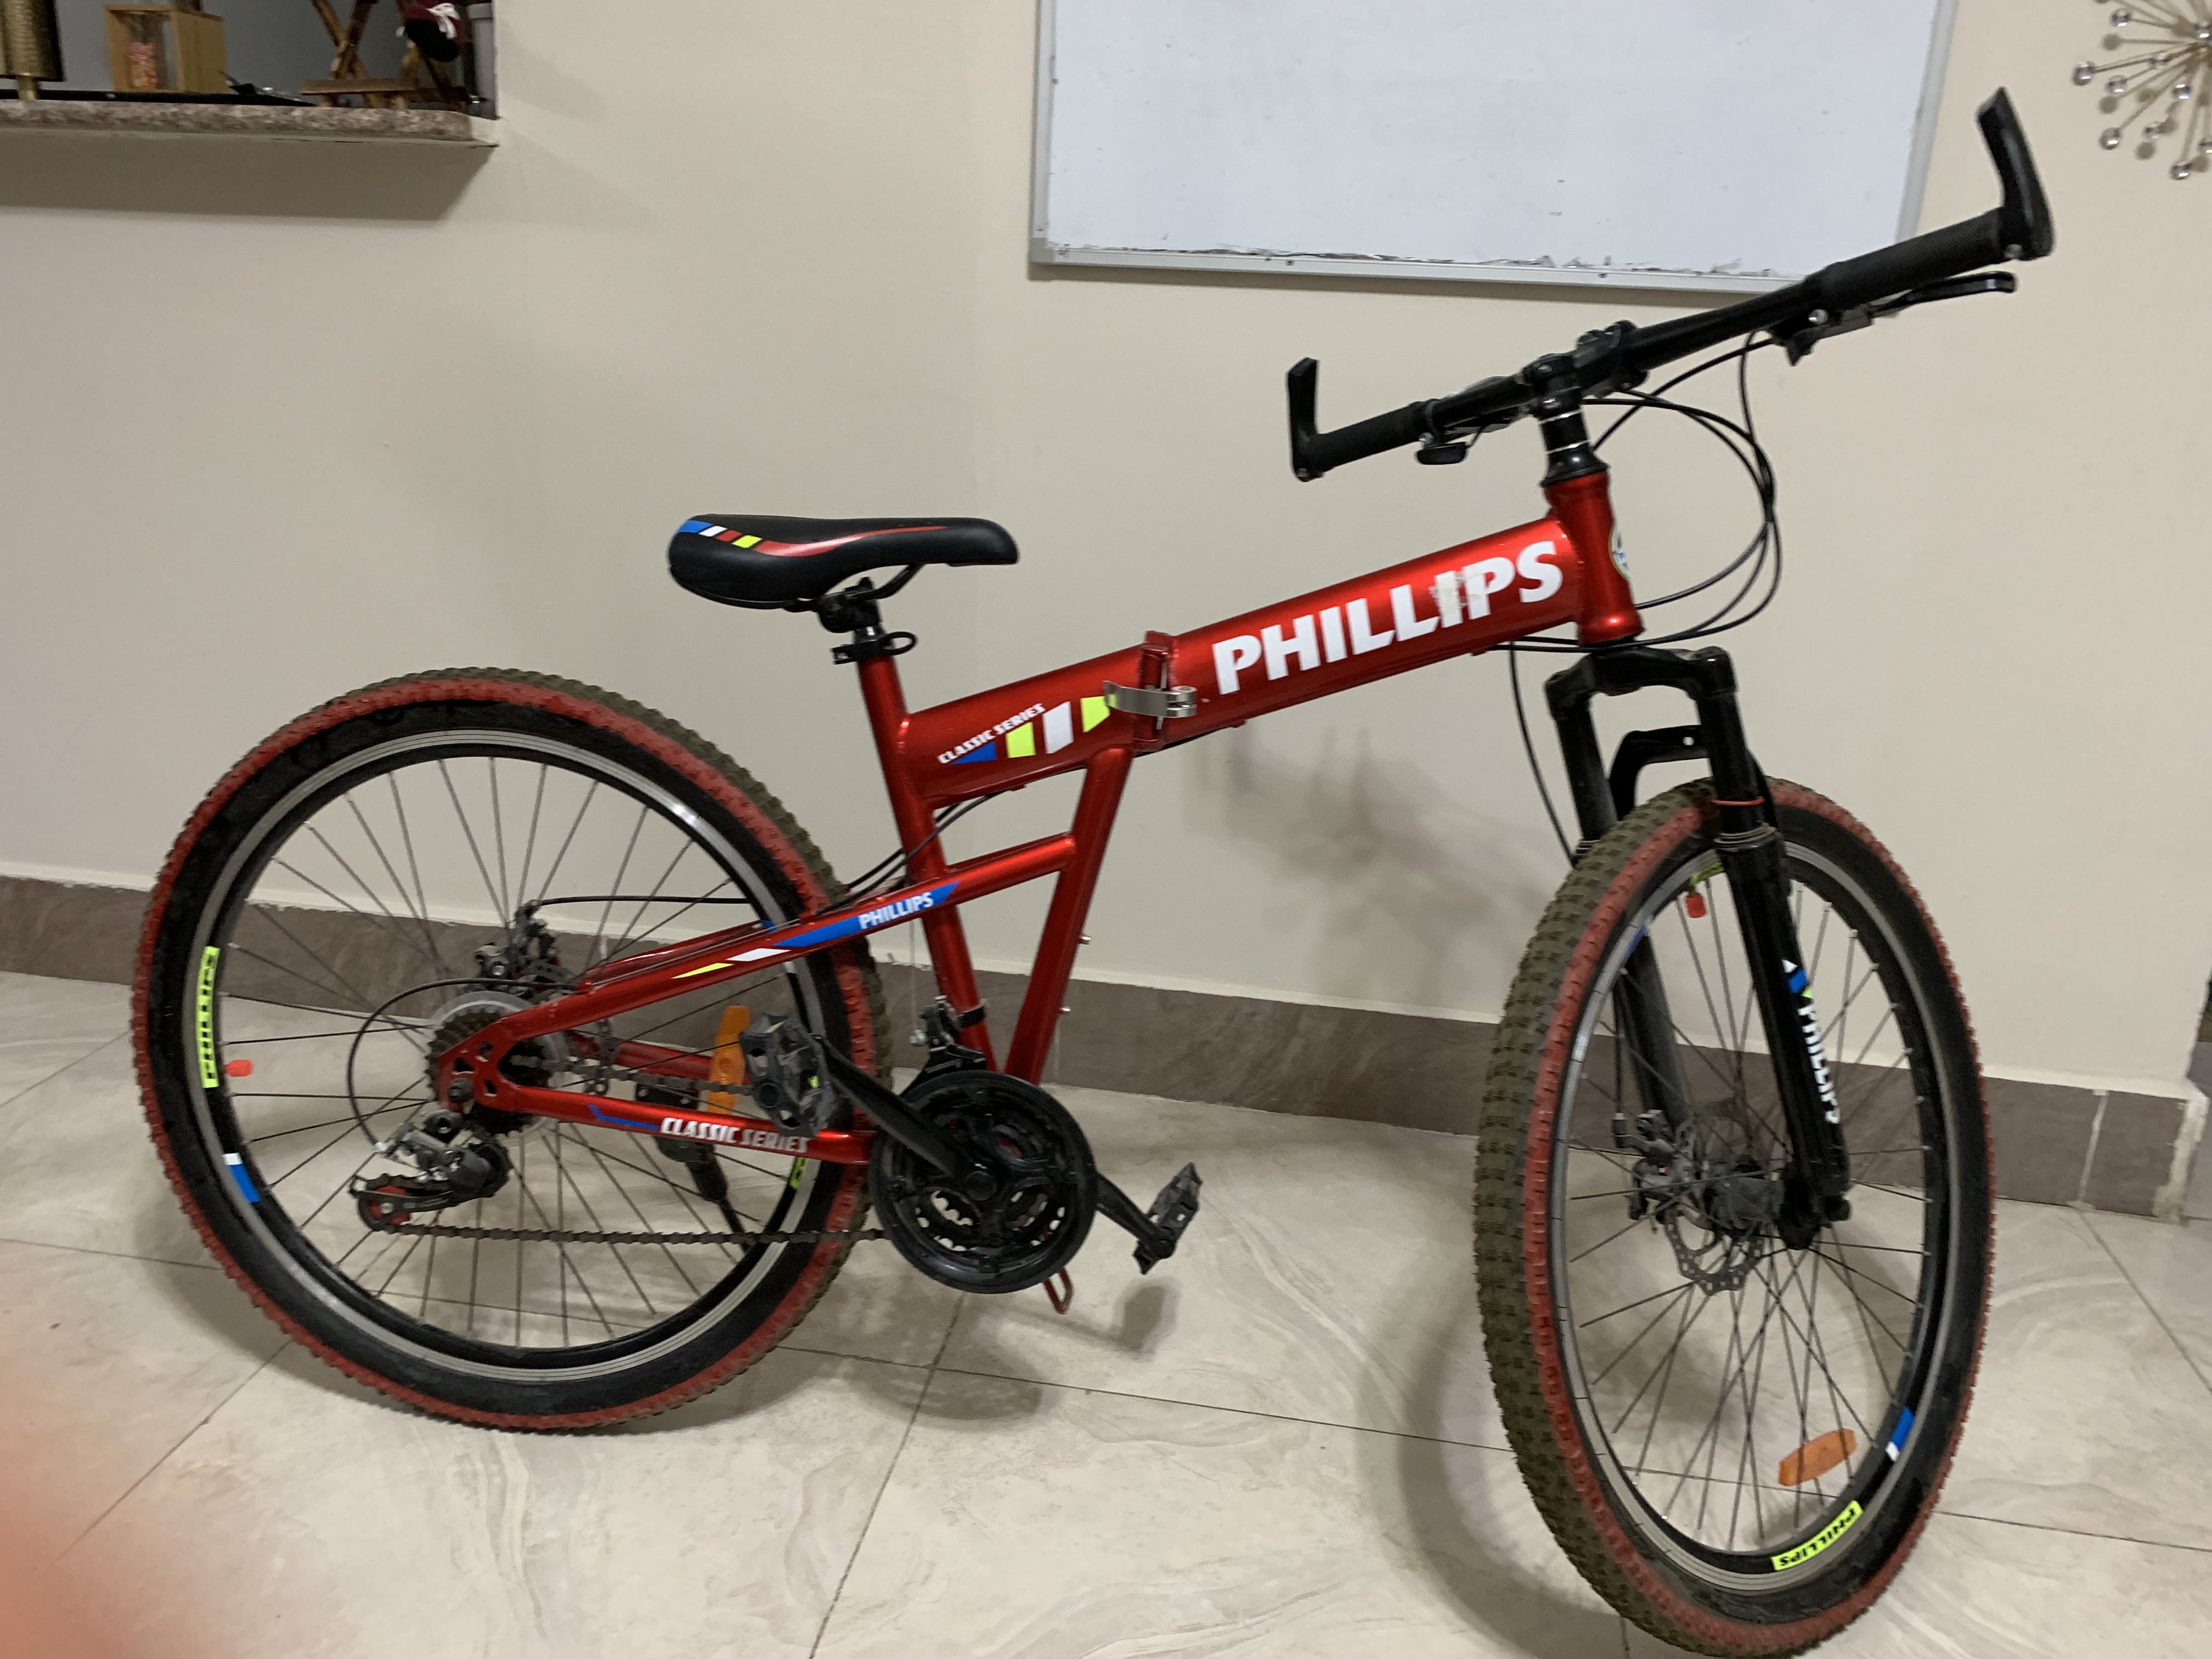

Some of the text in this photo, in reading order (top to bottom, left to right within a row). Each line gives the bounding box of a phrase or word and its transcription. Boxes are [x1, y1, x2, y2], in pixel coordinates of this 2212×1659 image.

[1212, 541, 1564, 695] PHILLIPS
[937, 703, 1046, 764] CLASSIC SERIES
[858, 891, 934, 929] PHILLIPS
[660, 1117, 741, 1144] CLASSIC
[1779, 1508, 1855, 1566] PHILLIPS
